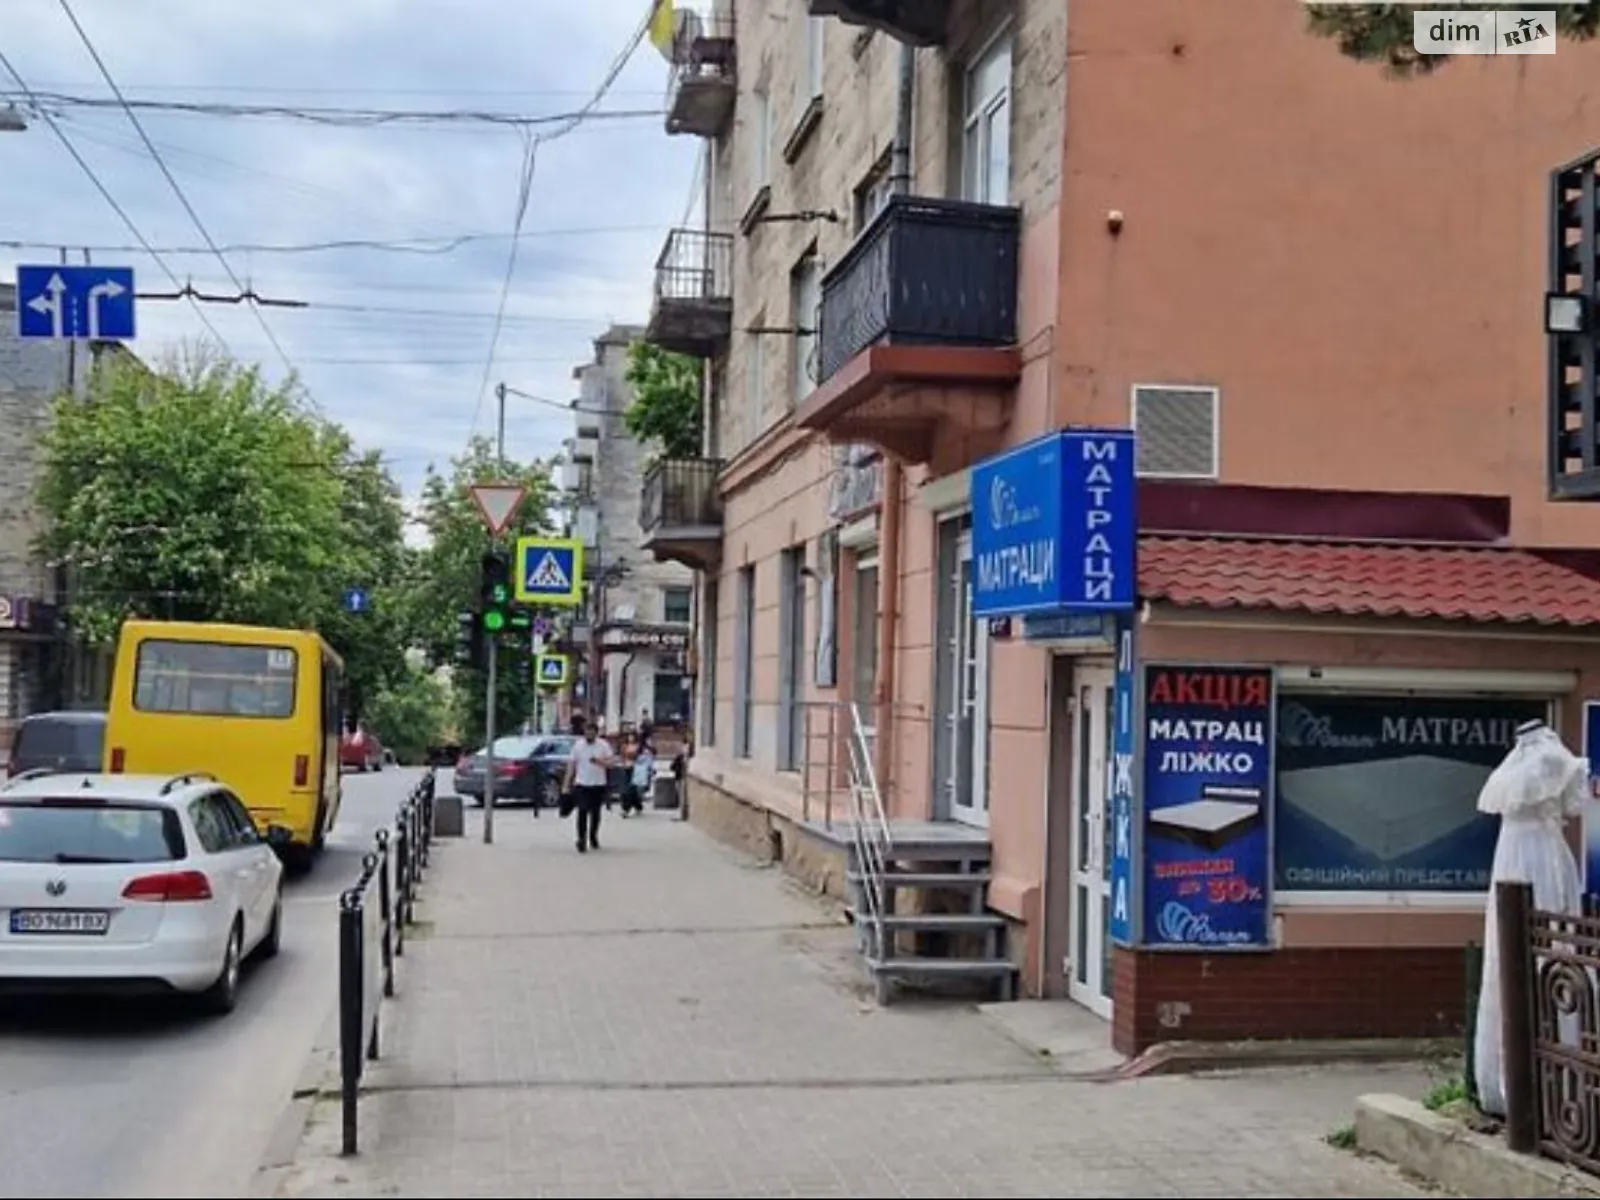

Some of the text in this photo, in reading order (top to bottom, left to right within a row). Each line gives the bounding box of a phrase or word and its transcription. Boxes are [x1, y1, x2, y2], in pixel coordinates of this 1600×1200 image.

[1083, 441, 1117, 600] МАТРАЦИ
[977, 538, 1054, 592] МАТРАЦИ
[1150, 672, 1268, 710] АКЦІЯ
[1150, 719, 1264, 745] МАТРАЦ
[1380, 715, 1518, 750] МАТРАЦ
[1114, 630, 1133, 921] ЛІЖКА
[1159, 751, 1253, 773] ЛІЖКО
